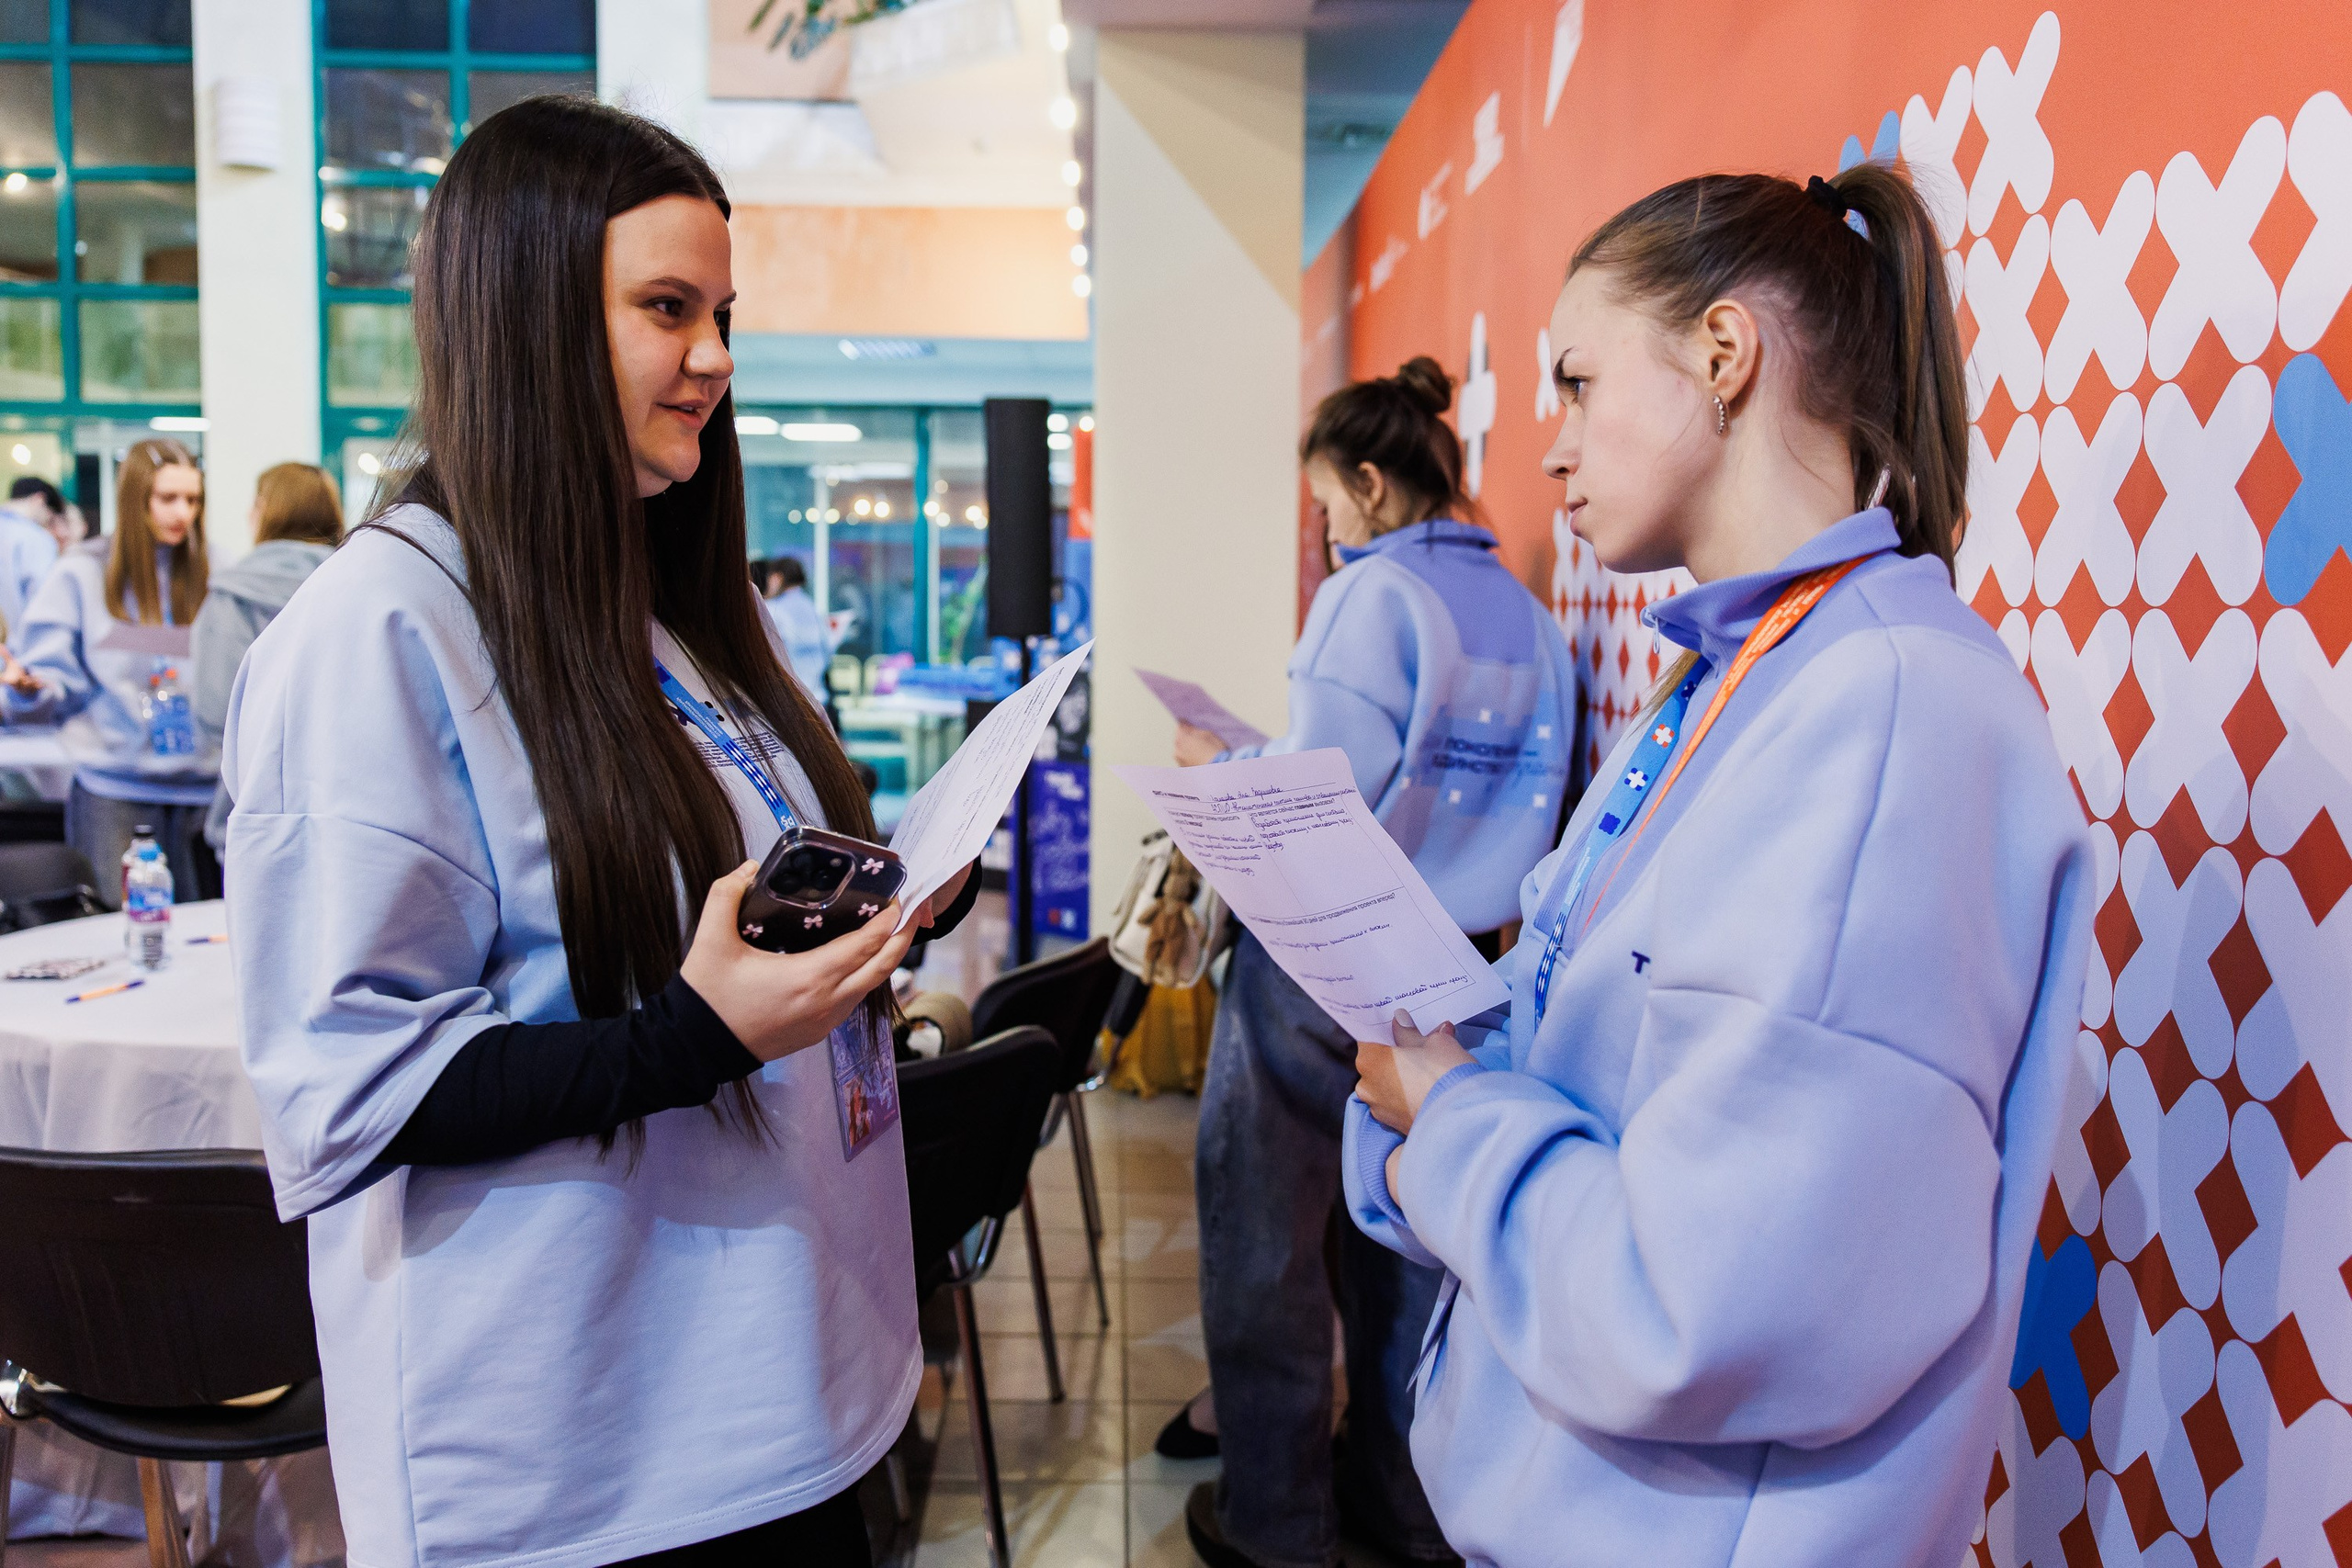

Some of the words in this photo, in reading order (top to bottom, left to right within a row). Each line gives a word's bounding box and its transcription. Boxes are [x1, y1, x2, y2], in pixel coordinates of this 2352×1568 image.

[1326, 906, 1358, 919] продвижения
[1358, 898, 1378, 911] проекта
[1377, 892, 1396, 904] вперед?
